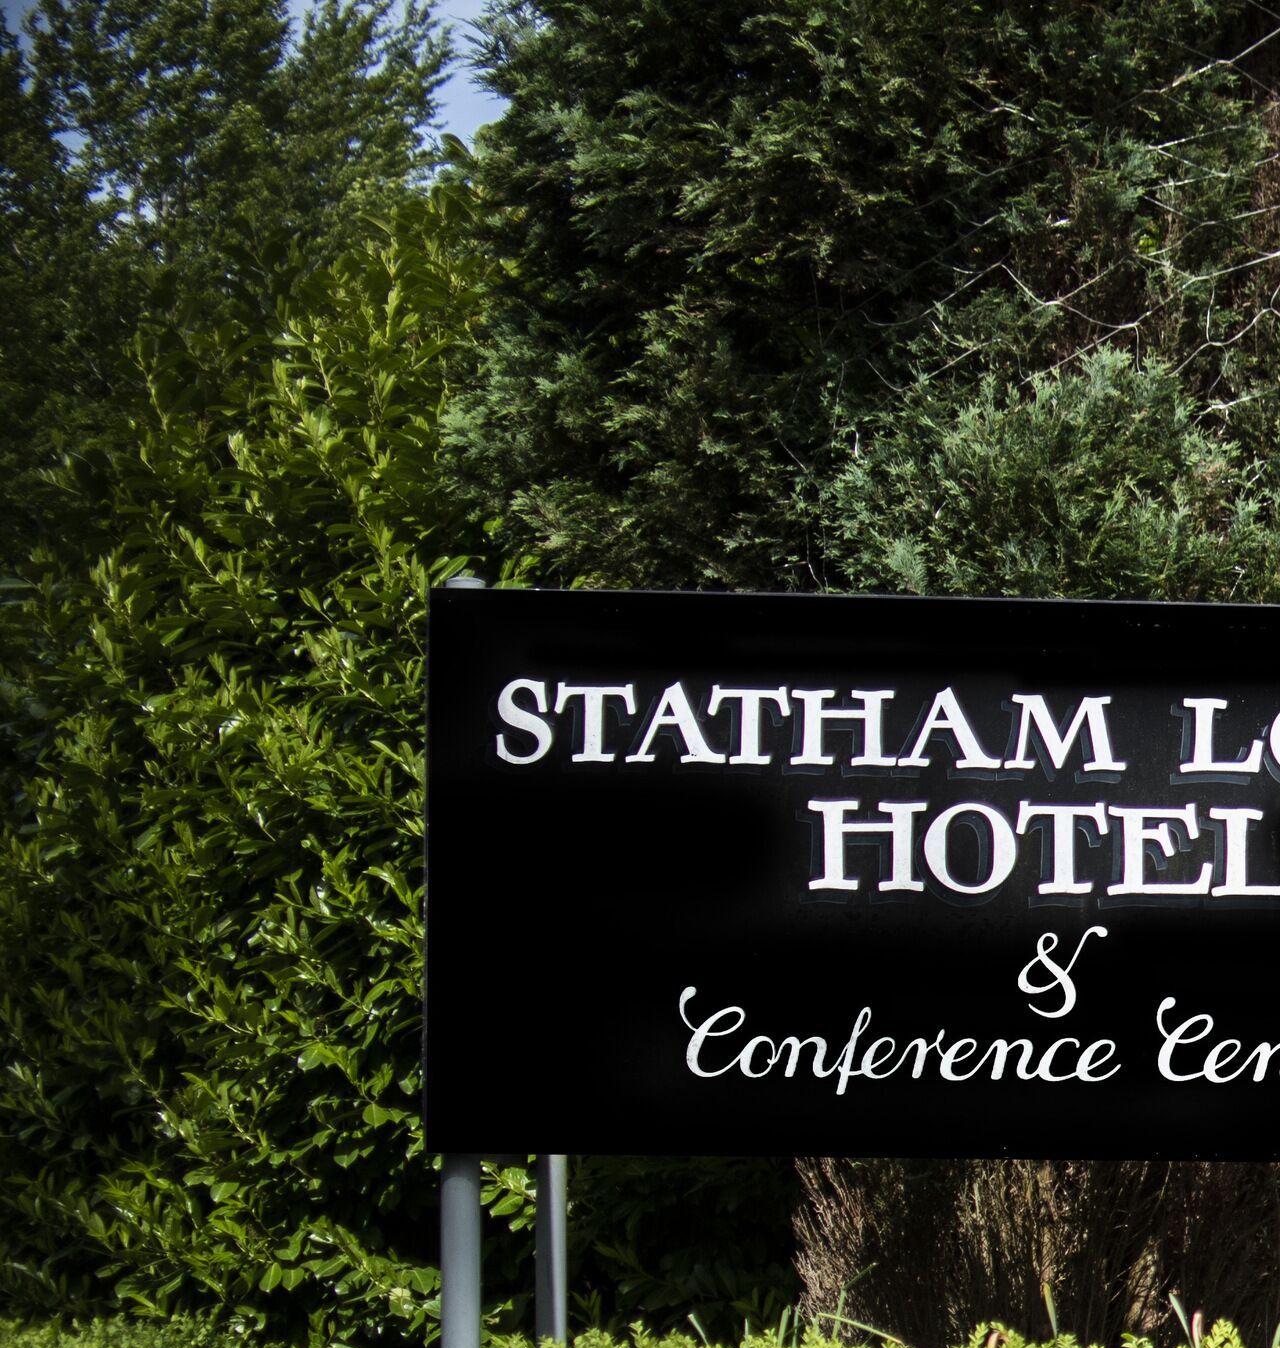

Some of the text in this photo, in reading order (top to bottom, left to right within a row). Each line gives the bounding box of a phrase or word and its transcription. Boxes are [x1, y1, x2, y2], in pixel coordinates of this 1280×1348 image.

[496, 678, 1127, 772] STATHAM
[1017, 925, 1108, 1019] &
[679, 986, 1122, 1096] Conference
